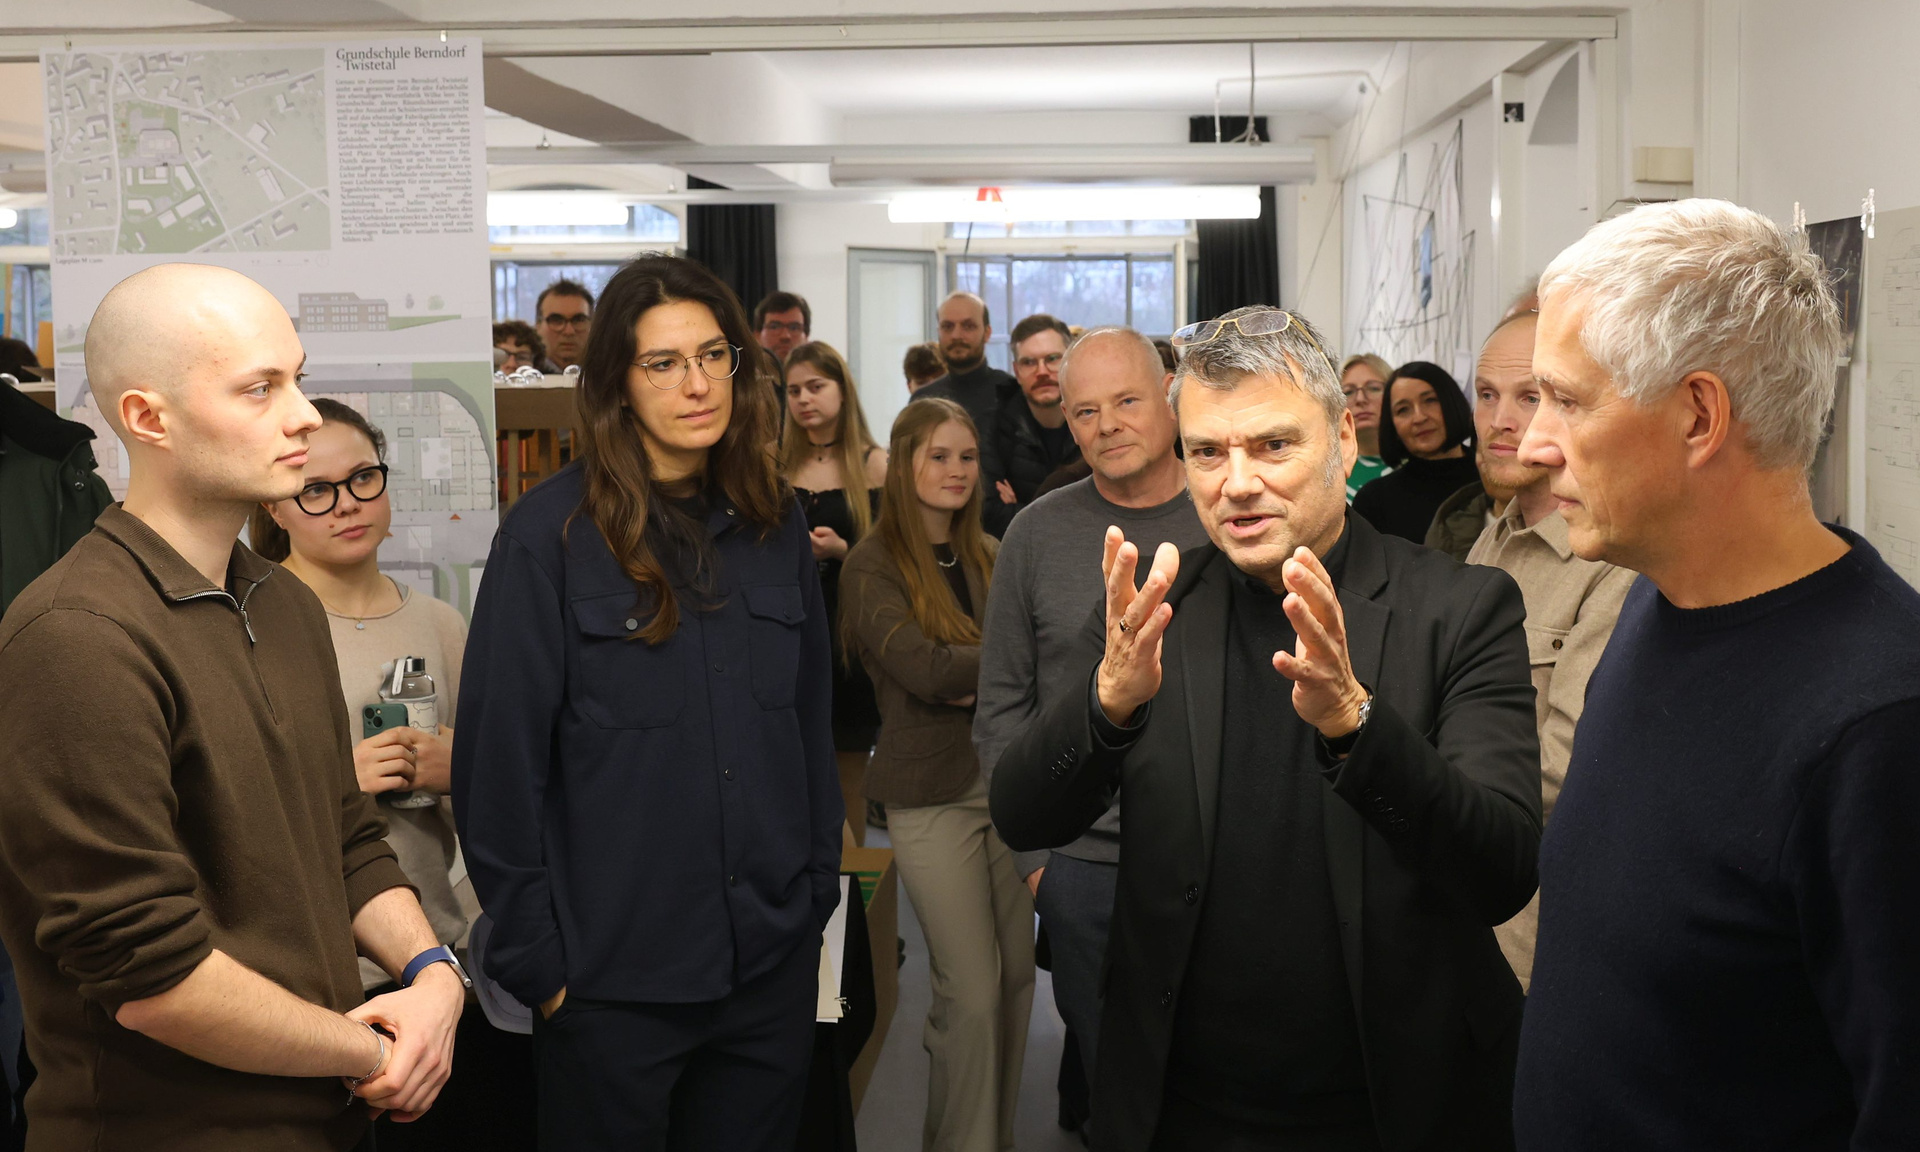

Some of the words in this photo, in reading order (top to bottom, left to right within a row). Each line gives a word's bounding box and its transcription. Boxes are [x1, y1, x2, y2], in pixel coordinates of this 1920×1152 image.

[336, 46, 411, 60] Grundschule
[414, 45, 468, 59] Berndorf
[344, 58, 396, 71] Twistetal
